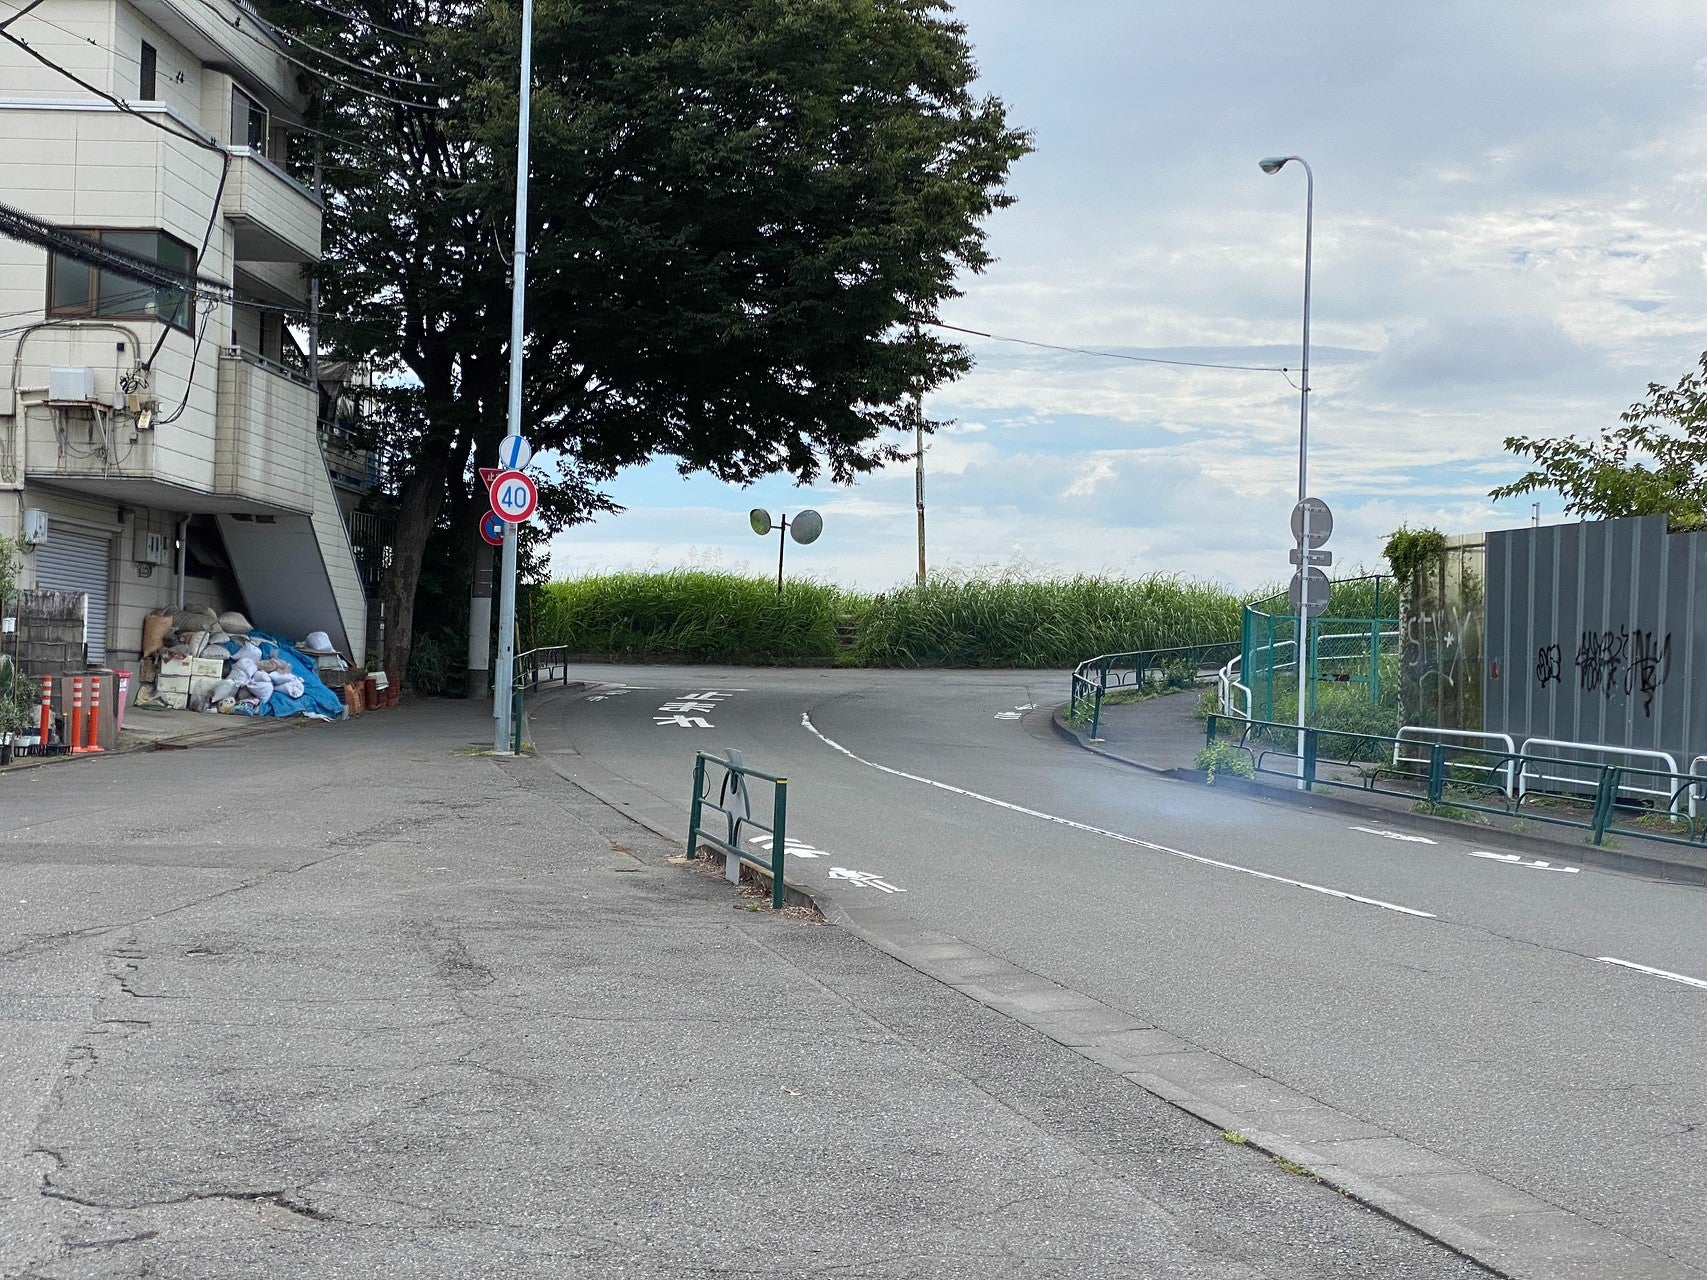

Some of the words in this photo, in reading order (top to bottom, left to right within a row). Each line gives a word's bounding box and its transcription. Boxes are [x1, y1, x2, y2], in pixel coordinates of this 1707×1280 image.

[502, 486, 527, 508] 40
[652, 691, 733, 728] 止まれ
